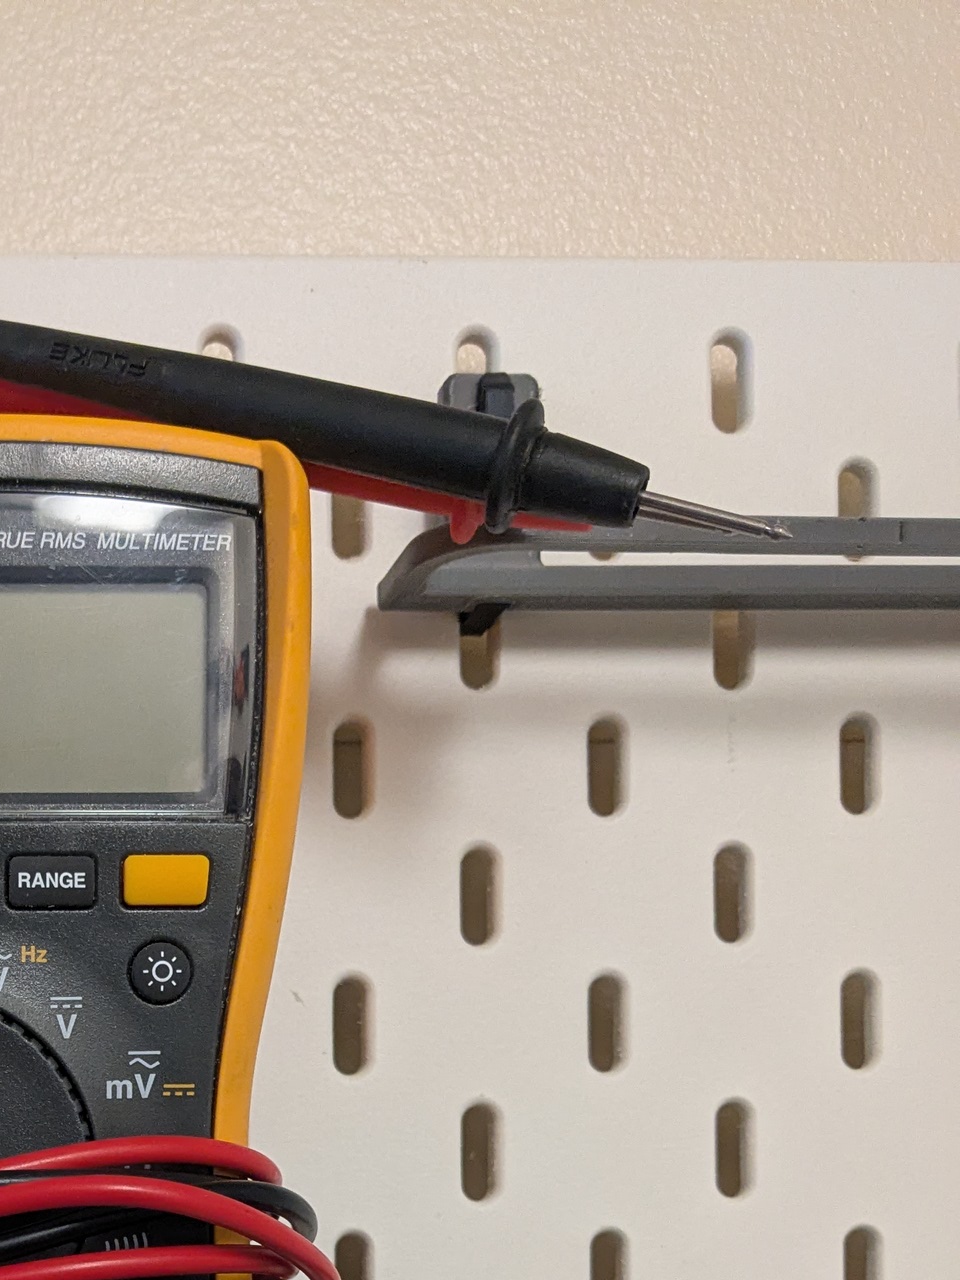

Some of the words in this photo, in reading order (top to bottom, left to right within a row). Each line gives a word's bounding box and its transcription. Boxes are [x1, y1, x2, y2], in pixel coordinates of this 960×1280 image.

[48, 342, 150, 379] FLUKE
[40, 531, 86, 549] RMS
[96, 532, 232, 552] MULTIMETER
[17, 872, 87, 890] RANGE
[20, 945, 48, 964] Hz
[56, 1013, 79, 1040] V
[105, 1073, 156, 1100] mV
